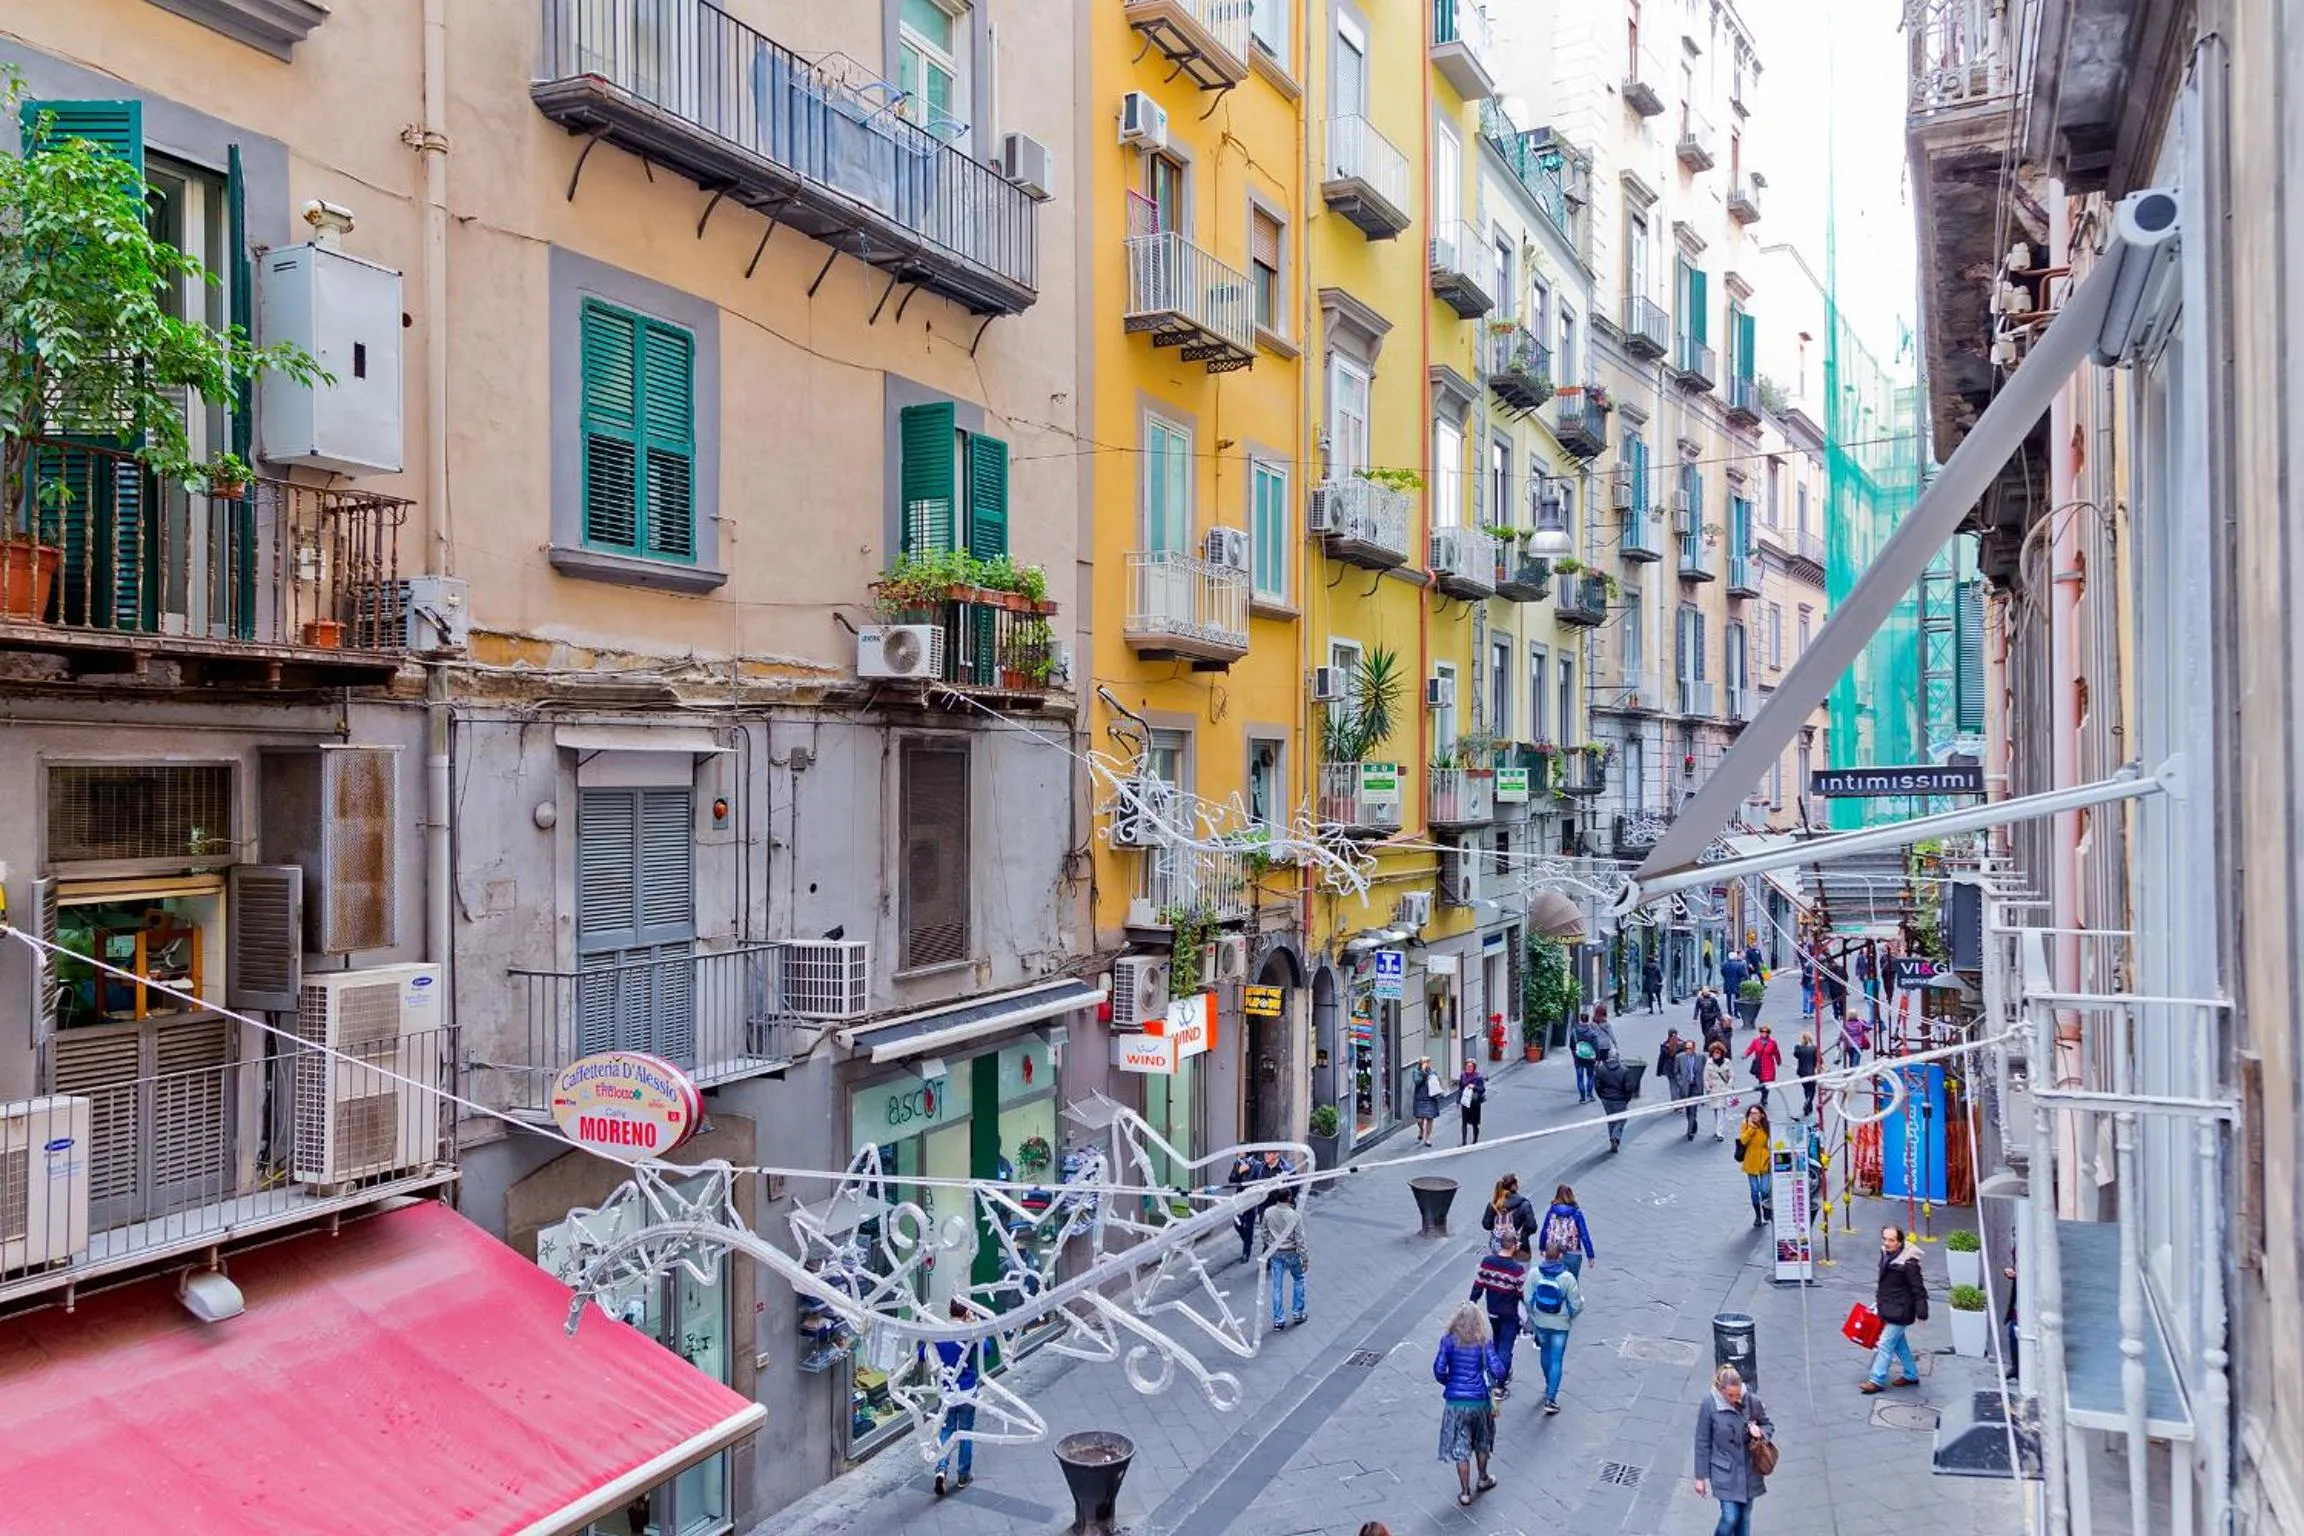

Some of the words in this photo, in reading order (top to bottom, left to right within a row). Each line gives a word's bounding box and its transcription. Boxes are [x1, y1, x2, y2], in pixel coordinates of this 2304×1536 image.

[1821, 774, 1975, 791] intimissimi
[1171, 1027, 1201, 1045] WIND
[1126, 1055, 1166, 1067] WIND
[561, 1061, 620, 1091] Caffetteria
[622, 1062, 677, 1103] D'Alessio
[579, 1116, 657, 1148] MORENO
